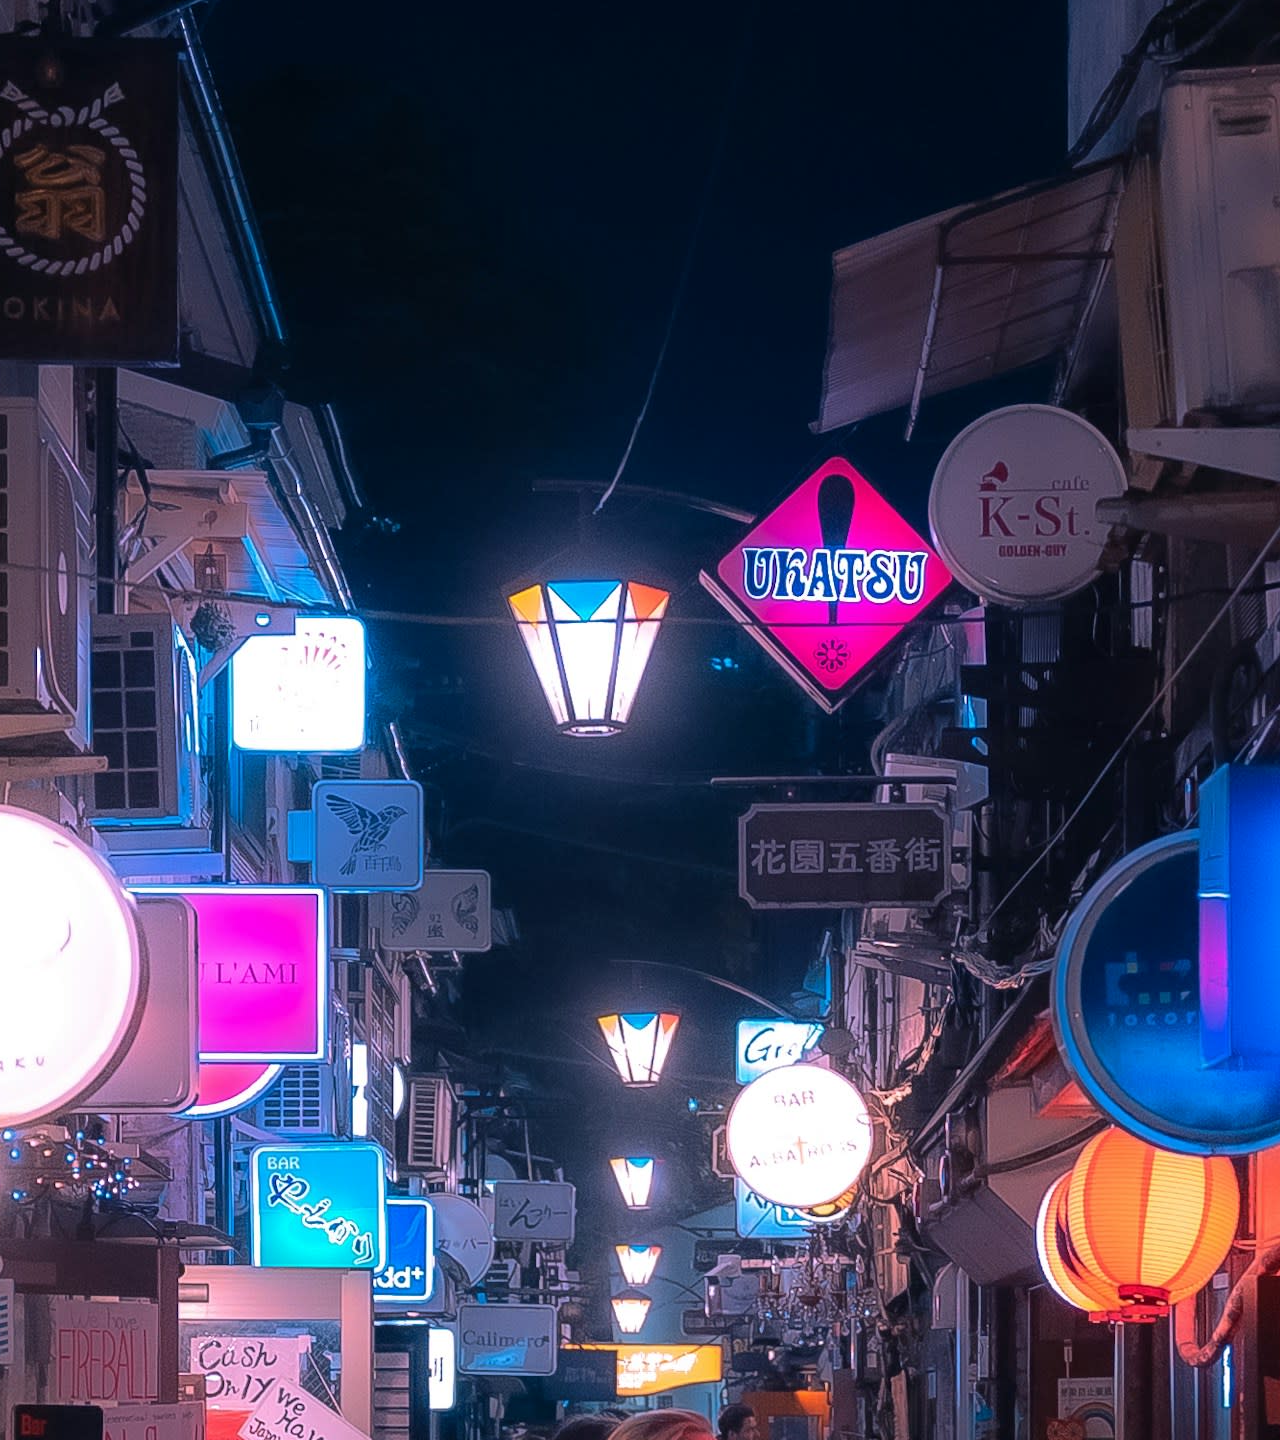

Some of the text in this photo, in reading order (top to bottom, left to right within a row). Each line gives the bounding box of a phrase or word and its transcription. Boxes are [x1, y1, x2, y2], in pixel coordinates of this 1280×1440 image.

[3, 296, 121, 321] OKINA
[1051, 476, 1090, 490] cafe
[978, 497, 1091, 539] K-St.
[741, 546, 929, 605] UKATSU
[750, 837, 942, 876] 花園五番街
[215, 962, 299, 984] L'AMI
[267, 1156, 300, 1170] BAR
[58, 1328, 159, 1401] FIREBALL
[199, 1341, 277, 1371] Cash
[277, 1387, 306, 1417] We
[21, 1414, 47, 1436] Bar
